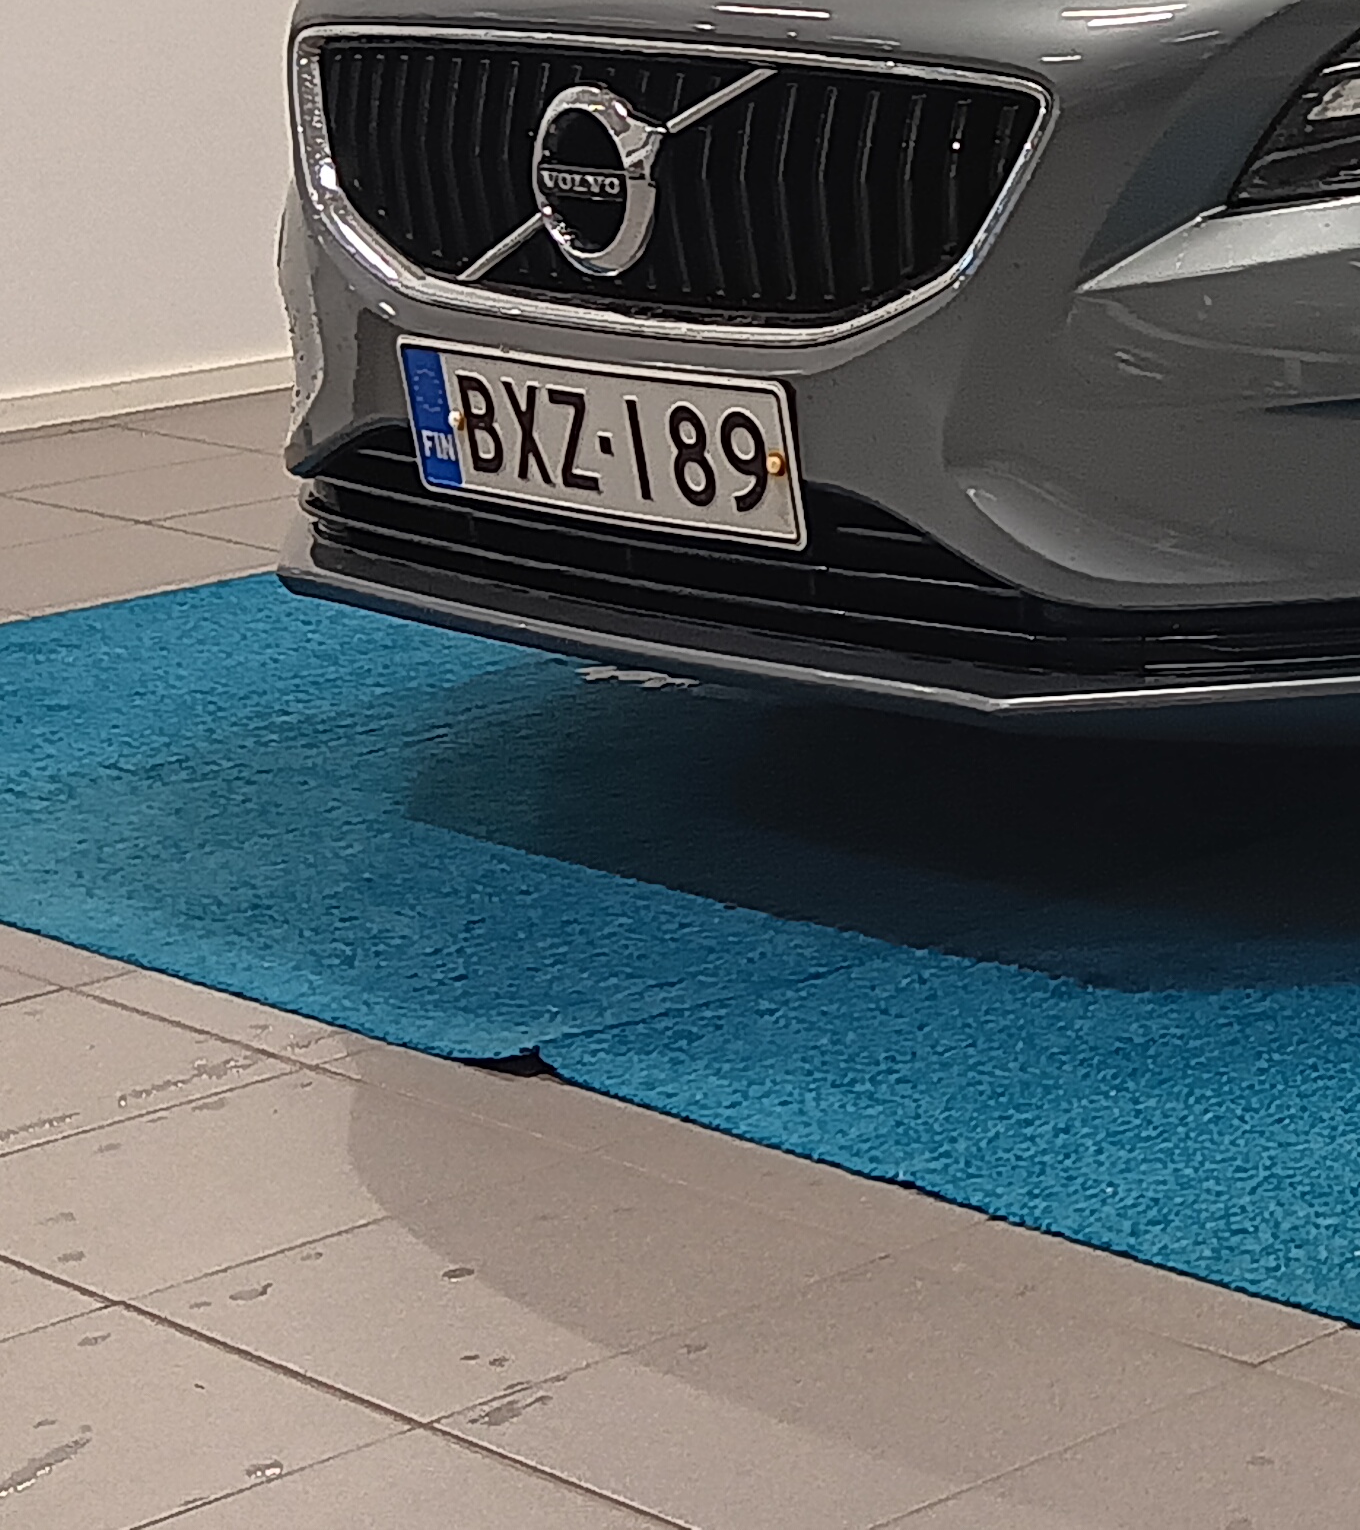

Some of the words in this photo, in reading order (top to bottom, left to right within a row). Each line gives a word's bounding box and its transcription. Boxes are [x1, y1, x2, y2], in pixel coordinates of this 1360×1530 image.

[540, 170, 620, 194] VOLVO
[421, 429, 456, 462] FIN
[455, 370, 768, 513] BXZ-189
